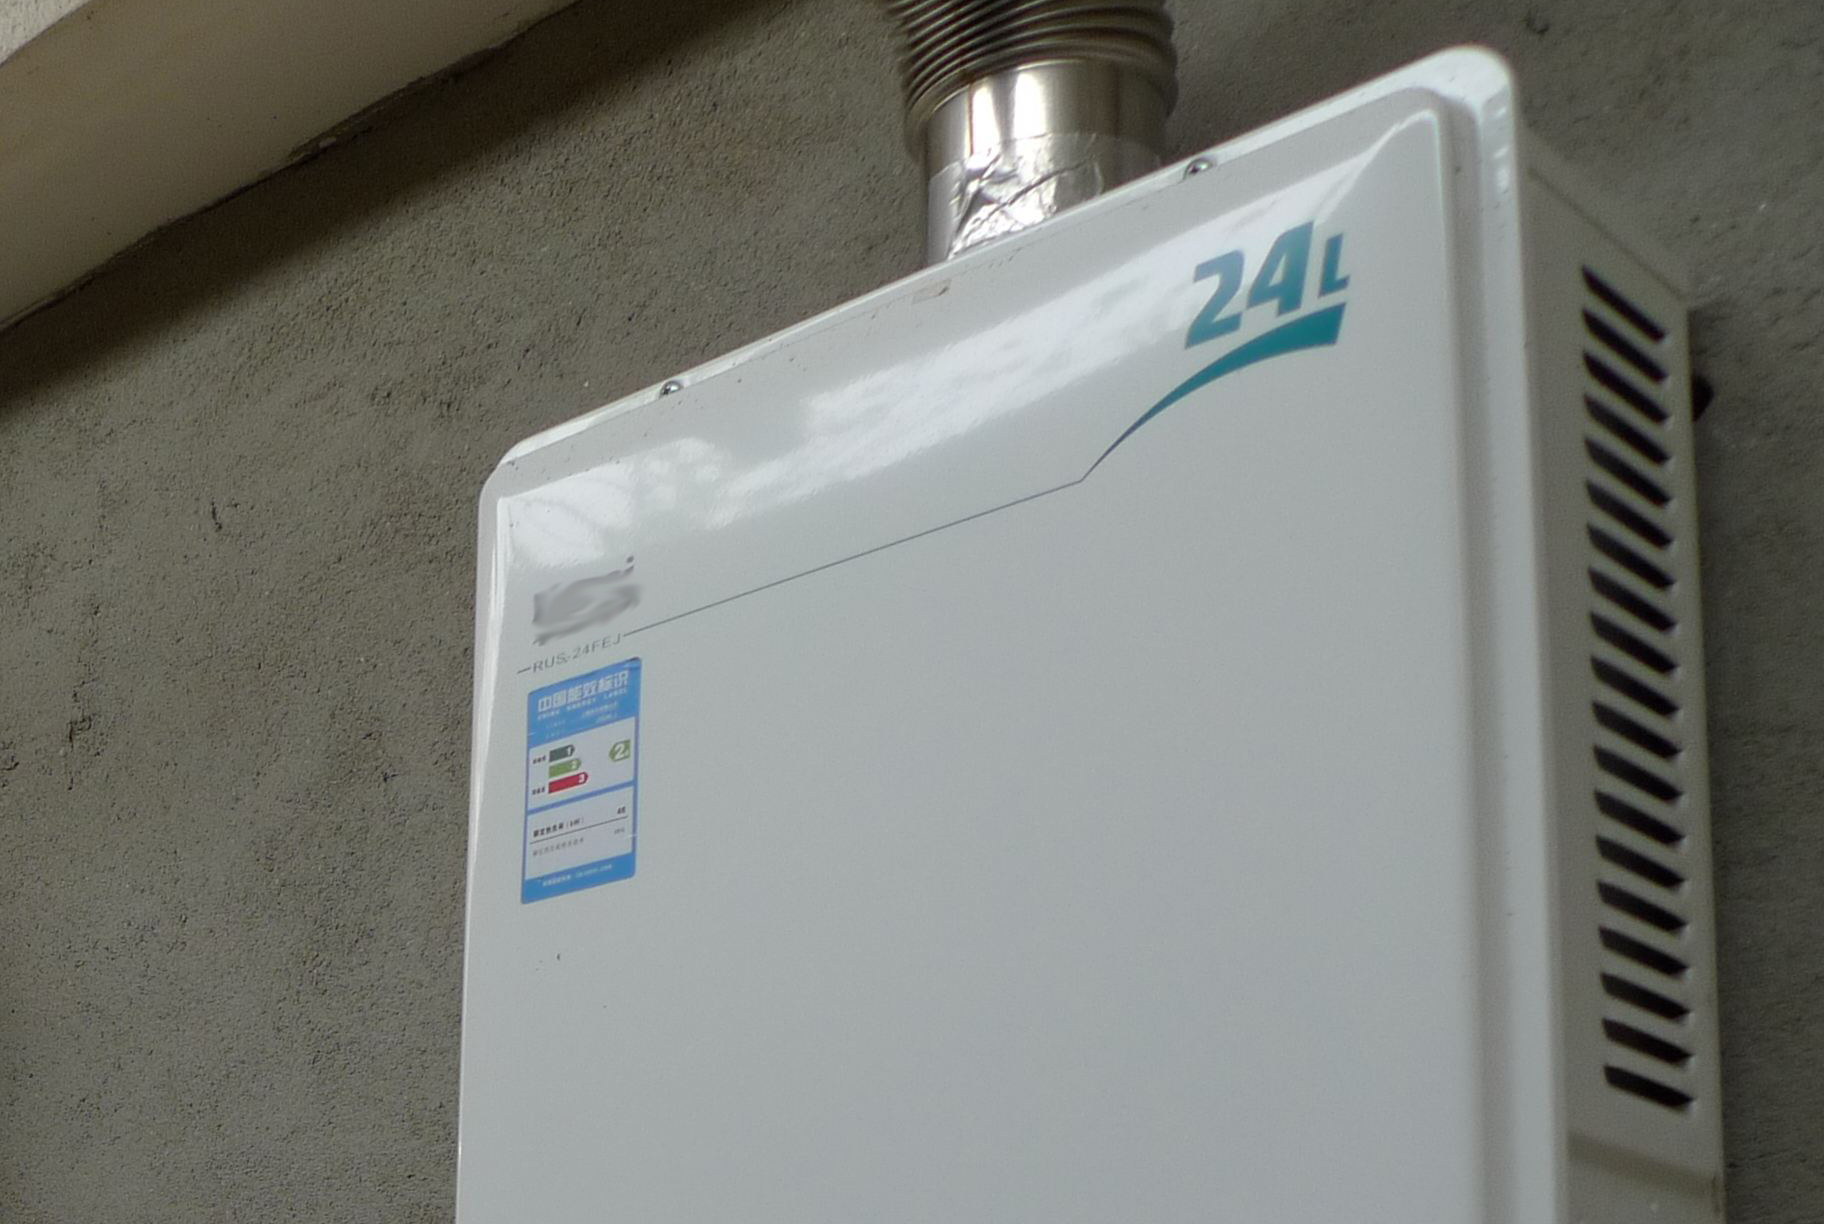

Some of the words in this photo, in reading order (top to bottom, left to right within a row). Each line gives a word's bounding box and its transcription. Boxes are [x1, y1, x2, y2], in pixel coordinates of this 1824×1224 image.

[1184, 220, 1351, 350] 24L
[537, 669, 629, 712] 中国能效标识
